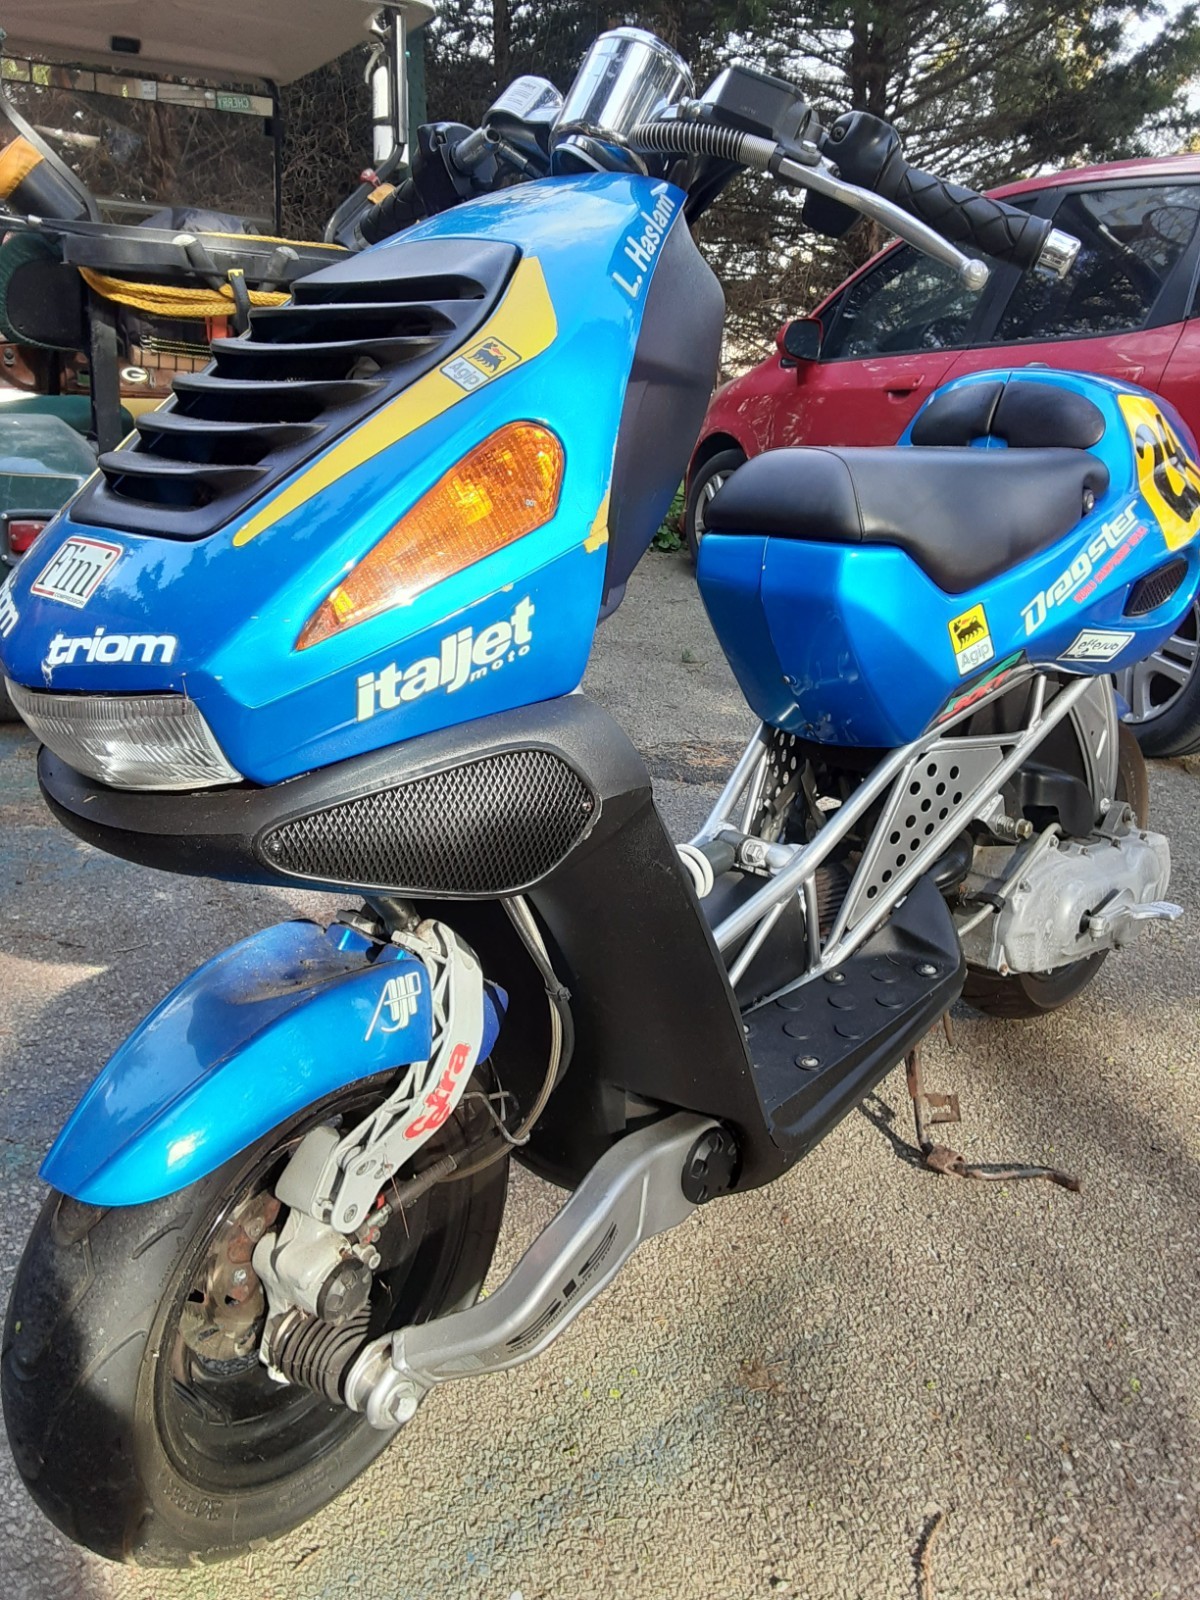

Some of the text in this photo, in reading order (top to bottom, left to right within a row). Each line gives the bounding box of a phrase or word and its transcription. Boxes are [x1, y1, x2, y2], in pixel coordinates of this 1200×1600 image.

[612, 193, 676, 298] L. Haslam
[449, 361, 481, 385] Agip
[38, 543, 113, 597] Fini
[1020, 499, 1139, 637] Dragster
[48, 627, 177, 664] triom
[357, 595, 535, 722] italjet
[470, 645, 530, 682] moto
[961, 641, 990, 669] Agip
[365, 971, 422, 1042] AJP
